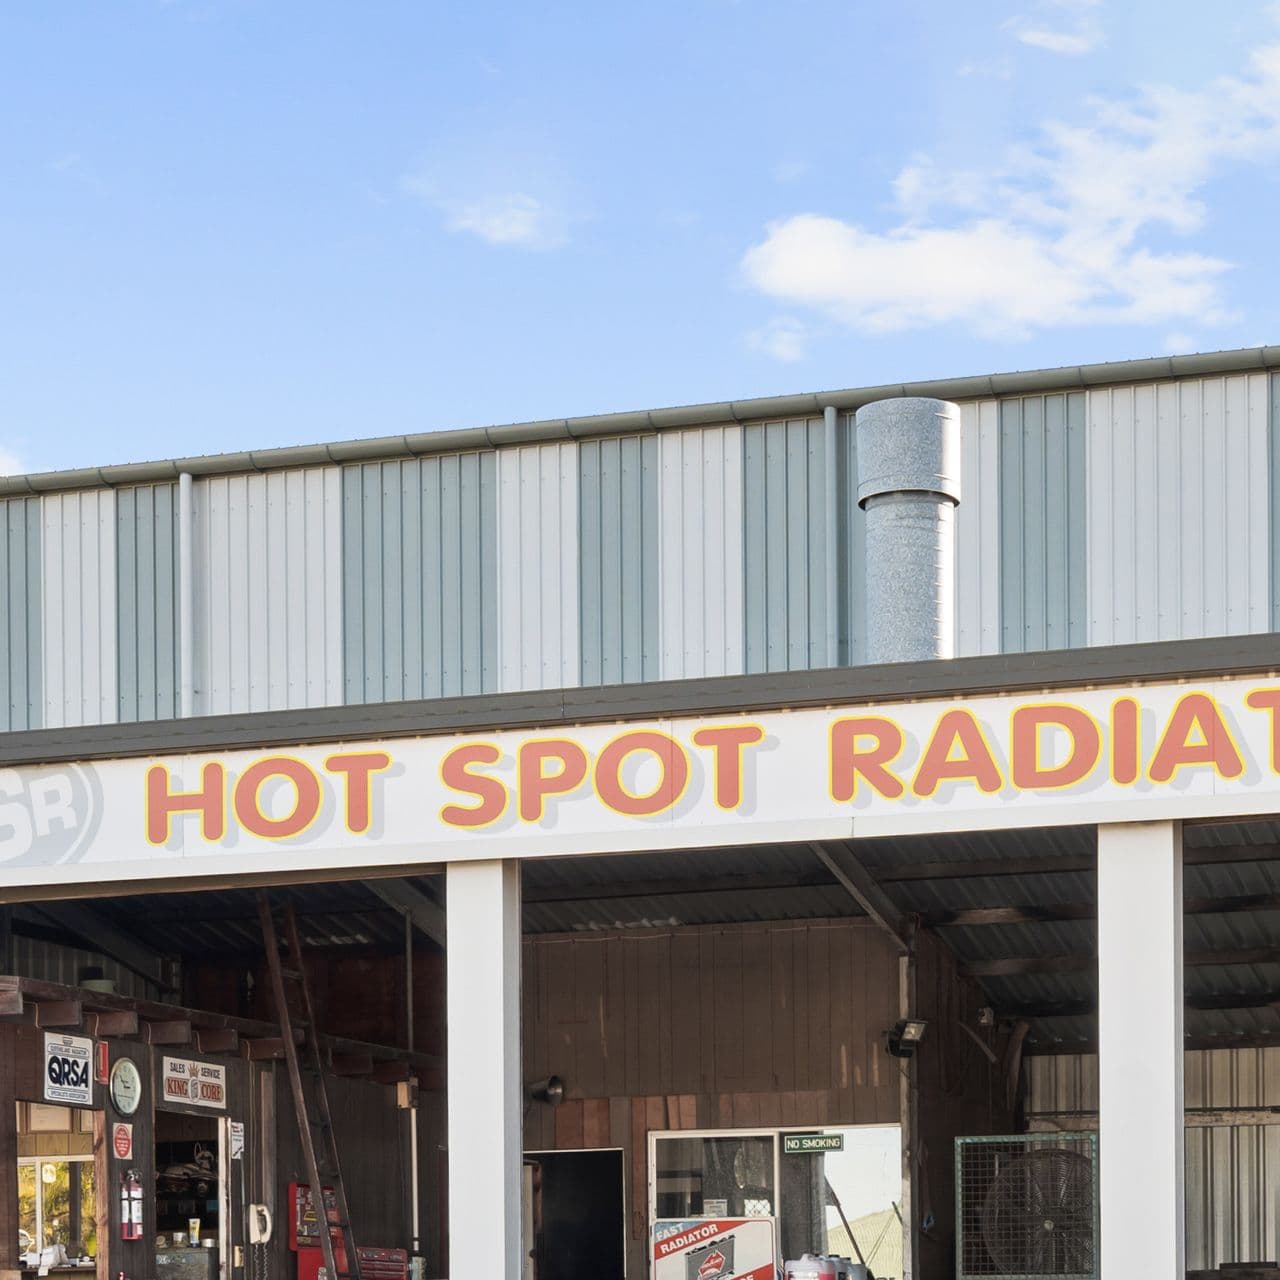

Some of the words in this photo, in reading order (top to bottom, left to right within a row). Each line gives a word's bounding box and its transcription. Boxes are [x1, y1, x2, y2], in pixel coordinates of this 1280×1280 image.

[145, 751, 391, 846] HOT
[439, 724, 765, 829] SPOT
[48, 1055, 89, 1089] QRSA
[169, 1062, 186, 1074] SALES
[167, 1079, 188, 1095] KING
[201, 1083, 222, 1100] CORE
[787, 1140, 800, 1149] NO
[802, 1138, 841, 1149] SMOKING
[655, 1223, 686, 1241] FAST
[660, 1224, 719, 1254] RADIATOR
